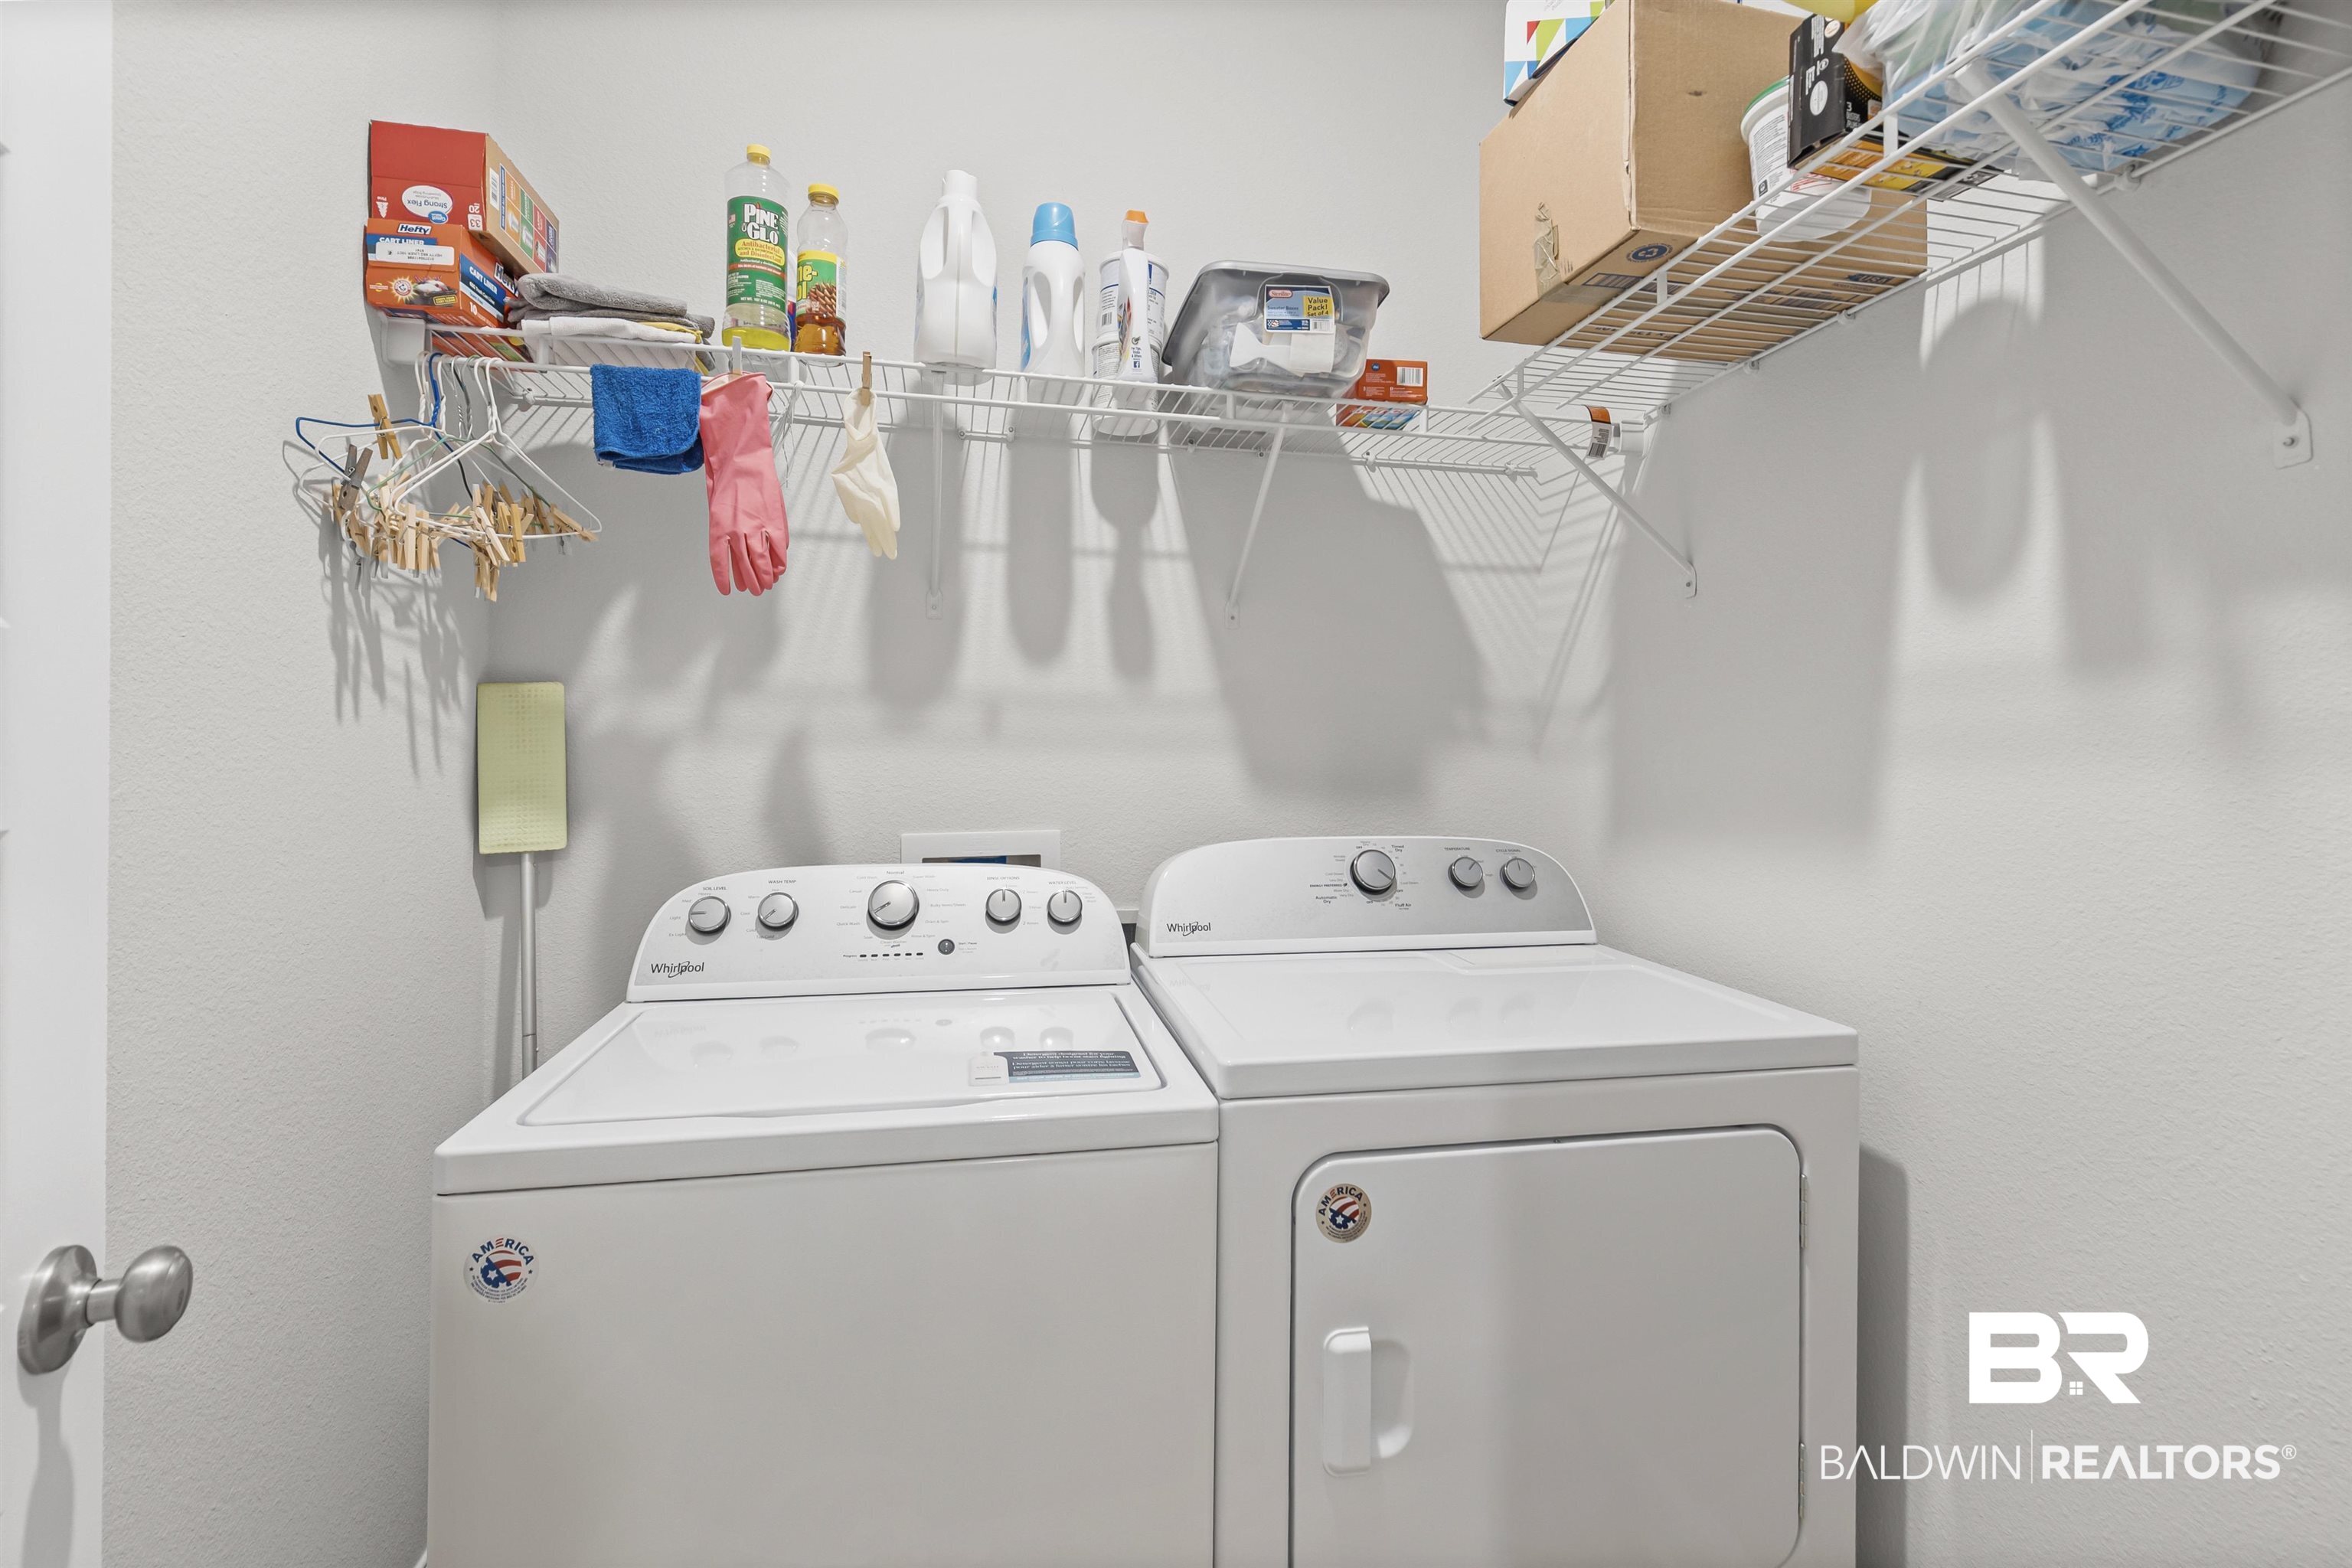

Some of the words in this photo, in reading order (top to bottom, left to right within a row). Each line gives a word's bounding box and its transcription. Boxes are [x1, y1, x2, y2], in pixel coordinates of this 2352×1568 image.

[1847, 101, 1853, 112] 3
[424, 199, 447, 208] Strong
[470, 219, 481, 228] 33
[744, 204, 778, 230] PINE
[400, 225, 429, 234] Hefty
[747, 222, 779, 245] GLO
[741, 240, 780, 253] Antibacterial
[750, 250, 781, 263] Disinfectant
[469, 266, 483, 282] CART
[484, 277, 498, 295] LINER
[1859, 274, 1888, 284] USA
[470, 302, 478, 315] 10
[1167, 922, 1211, 936] Whirlpool
[651, 961, 704, 978] Whirlpool
[1318, 1186, 1363, 1216] AMERICA
[472, 1237, 534, 1266] AMERICA
